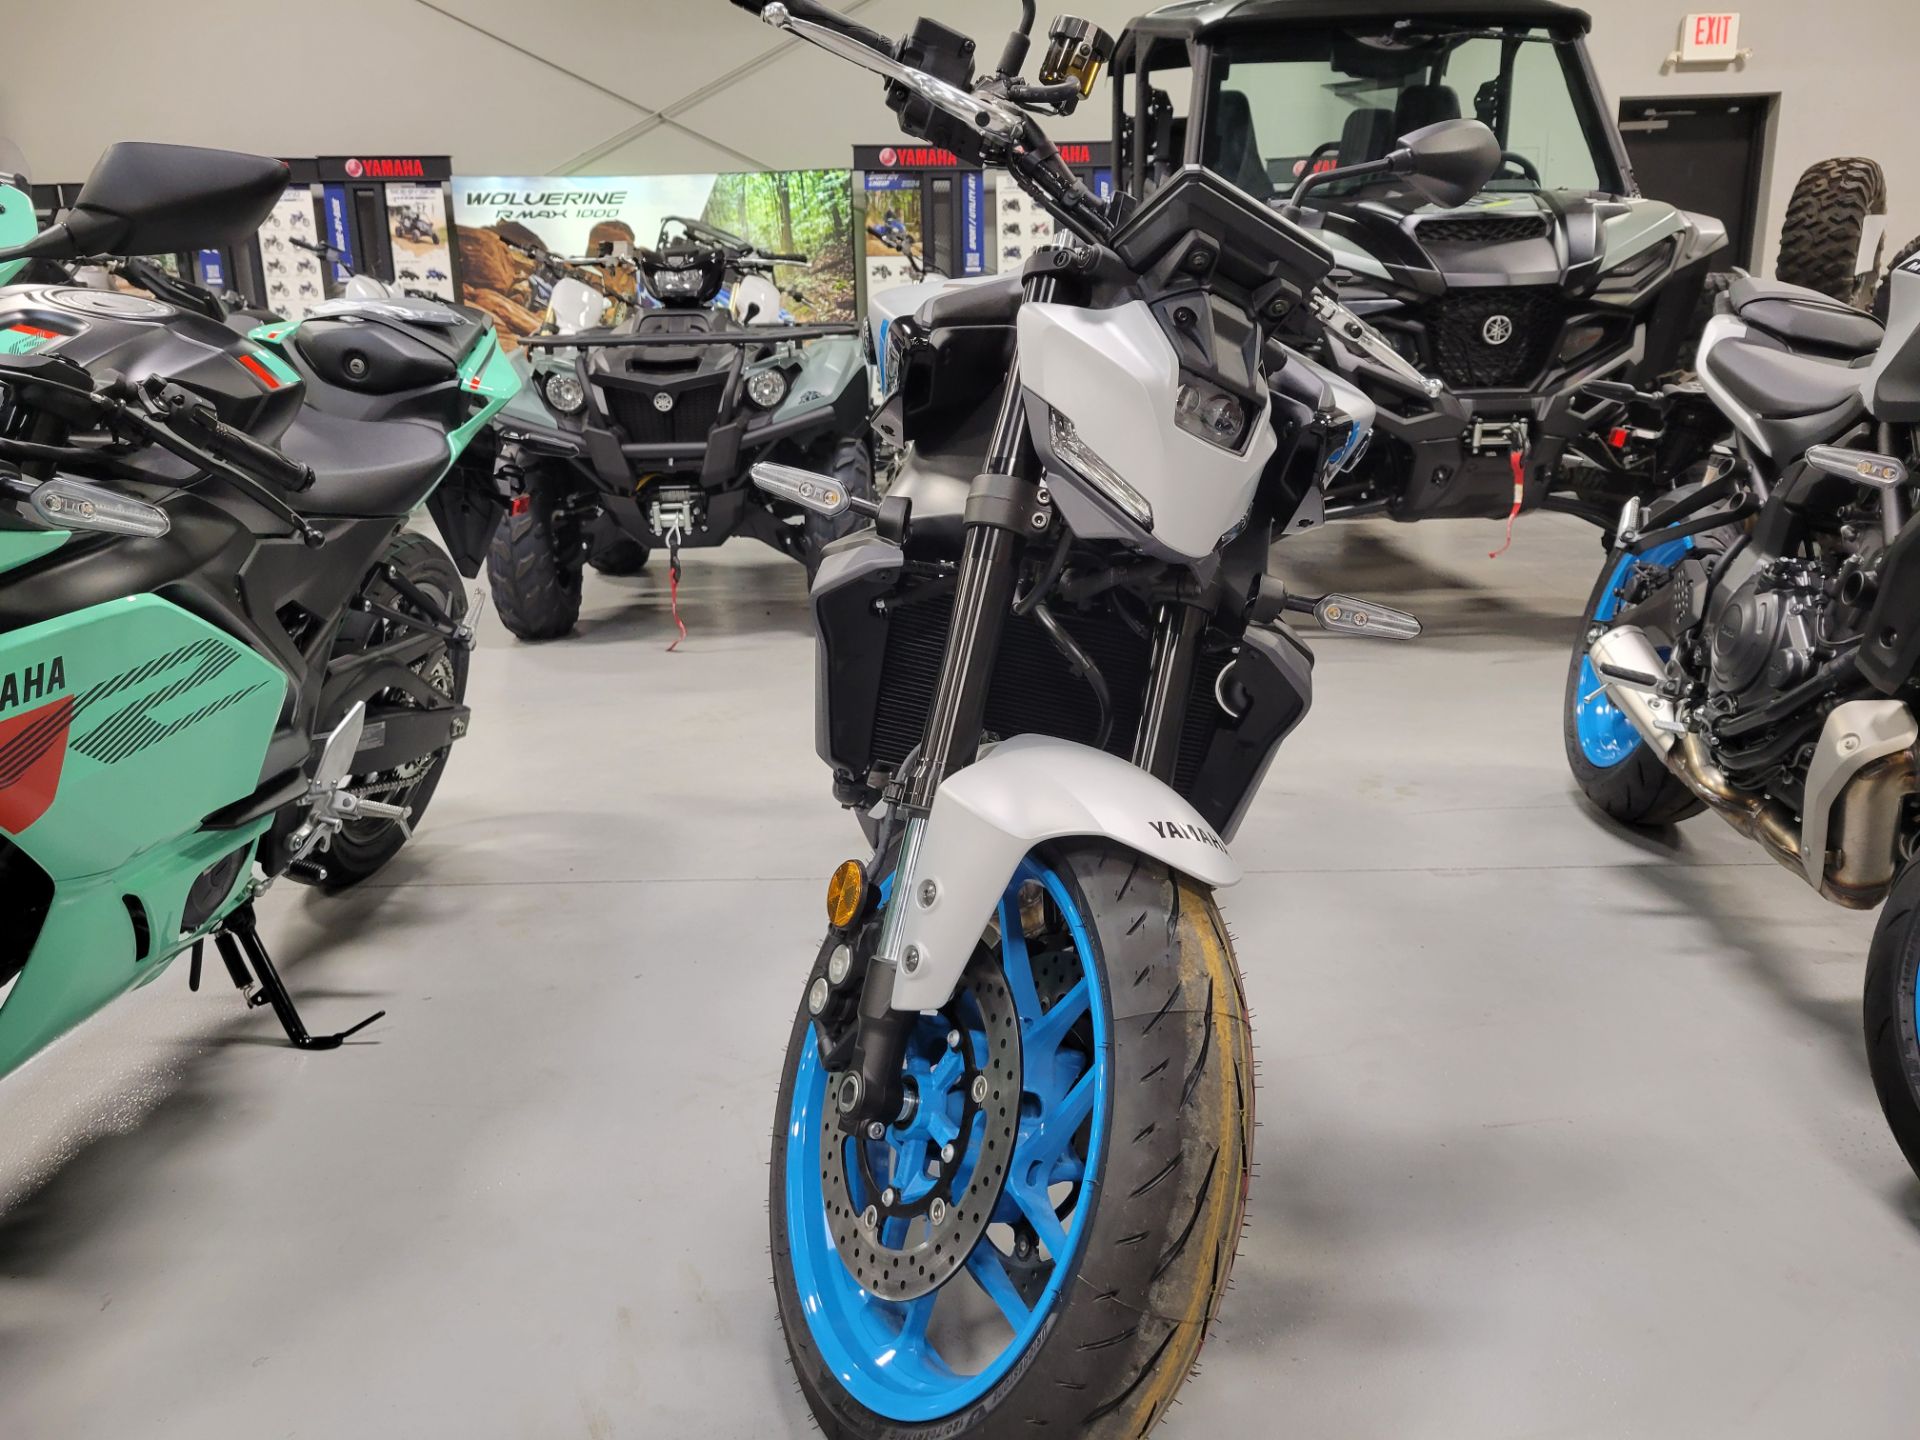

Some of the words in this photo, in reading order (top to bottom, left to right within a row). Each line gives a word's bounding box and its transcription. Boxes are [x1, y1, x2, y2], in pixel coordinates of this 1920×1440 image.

[1695, 16, 1732, 45] EXIT
[897, 148, 957, 167] YAMAHA
[1056, 145, 1090, 162] AHA
[362, 159, 424, 177] YAMAHA
[466, 191, 627, 206] WOLVERINE
[576, 208, 619, 218] 1000
[0, 655, 66, 712] AHA
